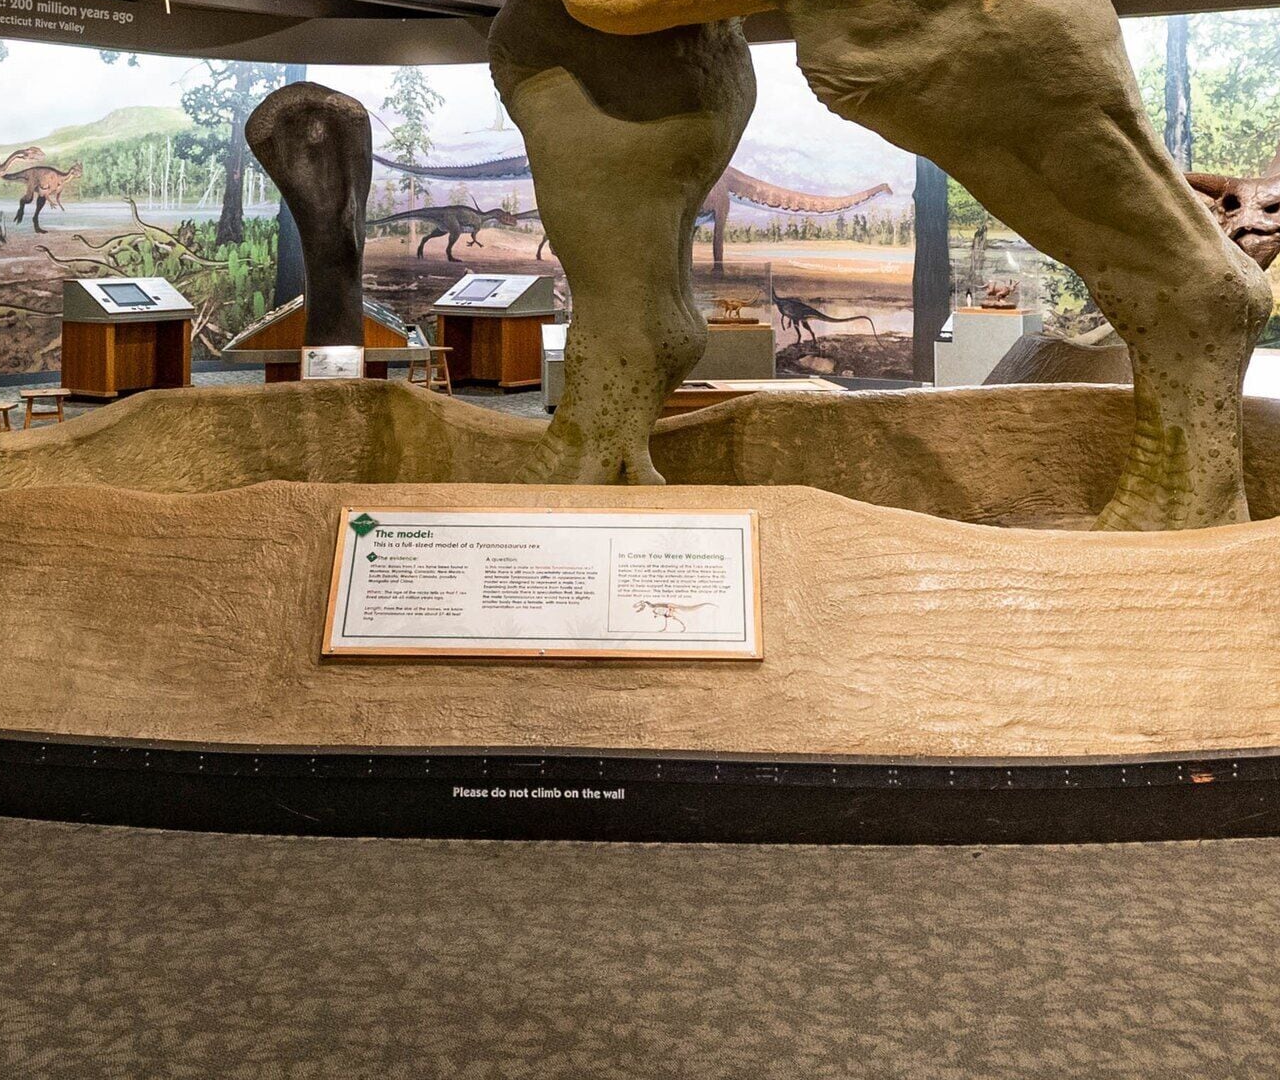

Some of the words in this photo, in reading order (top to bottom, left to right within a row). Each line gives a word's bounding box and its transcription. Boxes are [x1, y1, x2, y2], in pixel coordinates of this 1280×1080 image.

[36, 2, 77, 15] million
[79, 7, 109, 19] years
[112, 11, 133, 24] ago
[34, 17, 57, 29] River
[58, 21, 84, 33] Valley
[375, 529, 394, 538] The
[396, 529, 433, 538] model:
[476, 542, 527, 550] Tyrannosaurus
[649, 552, 662, 560] You
[452, 786, 488, 797] Please
[490, 787, 506, 797] do
[508, 788, 528, 797] not
[530, 787, 562, 798] climb
[563, 789, 579, 798] on
[581, 788, 601, 798] the
[602, 788, 624, 799] wall
